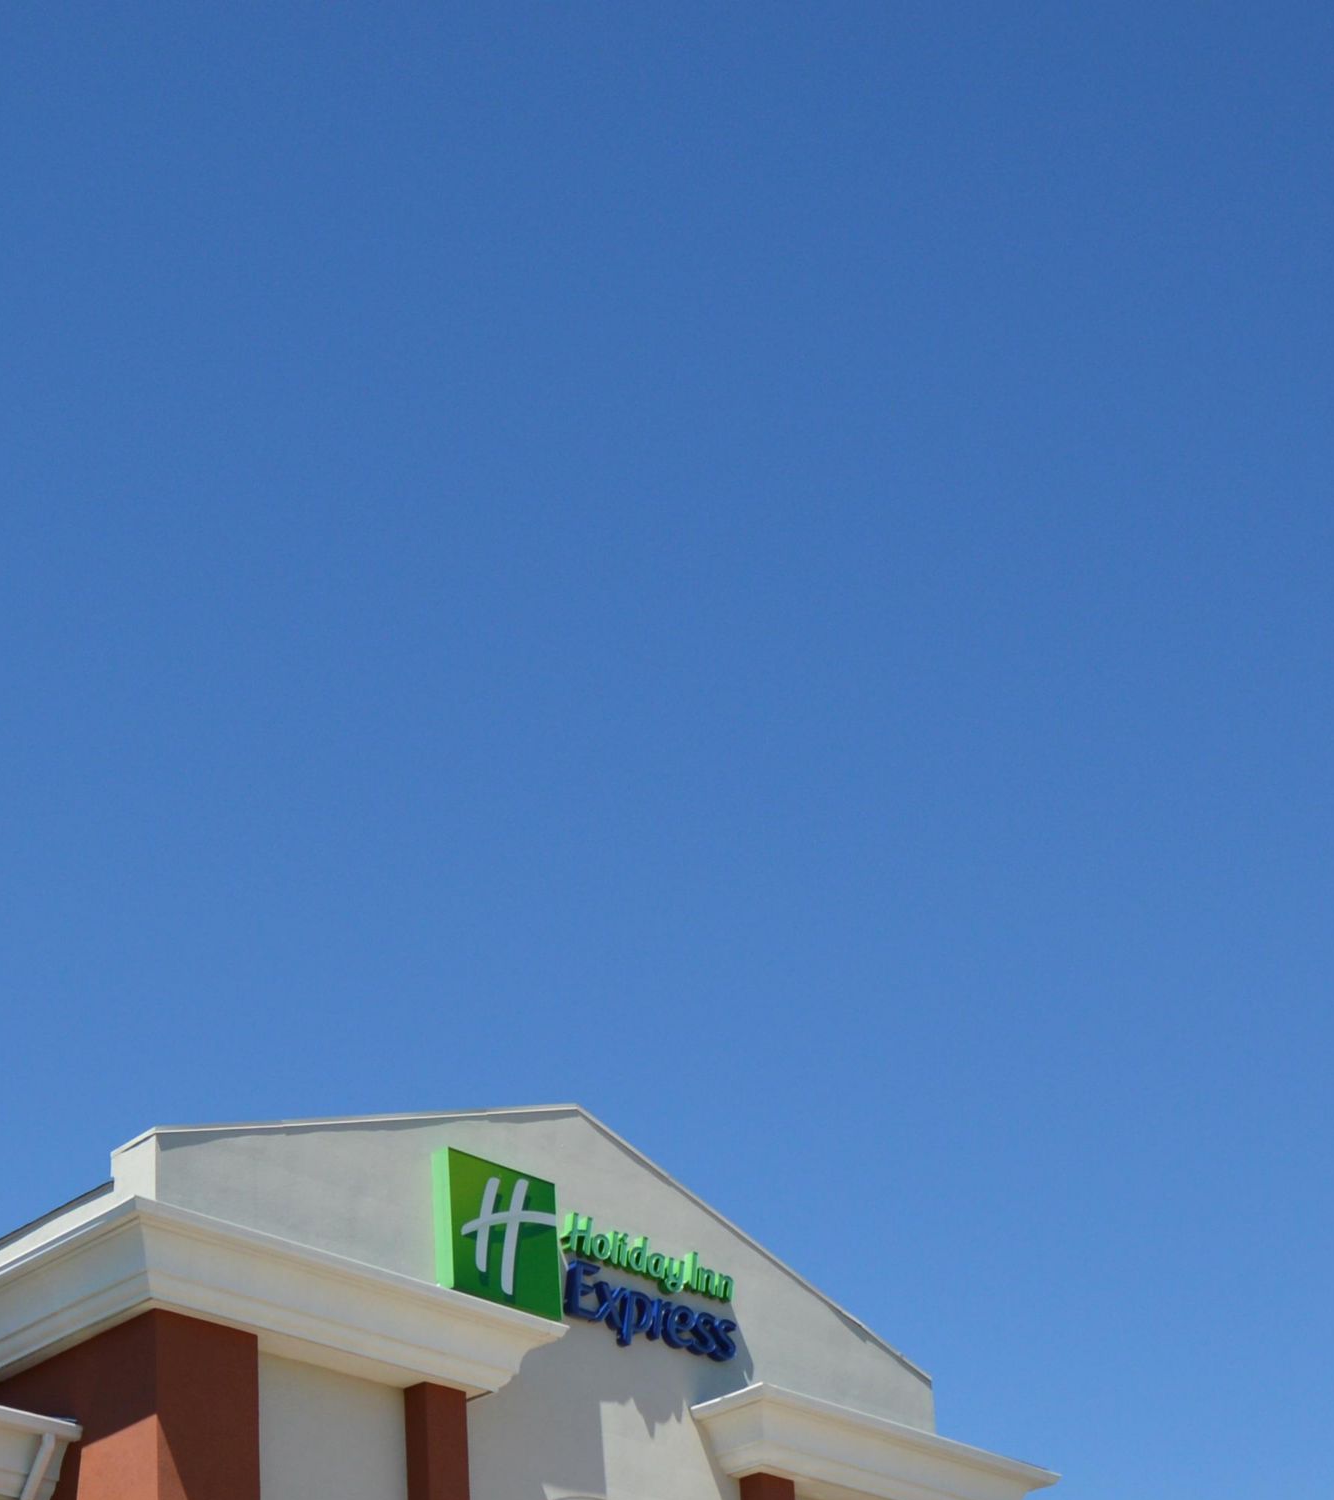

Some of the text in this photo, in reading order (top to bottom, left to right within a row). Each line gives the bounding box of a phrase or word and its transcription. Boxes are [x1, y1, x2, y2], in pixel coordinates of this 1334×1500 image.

[460, 1176, 557, 1296] H
[562, 1212, 734, 1302] Holiday Inn
[564, 1260, 737, 1362] Express
